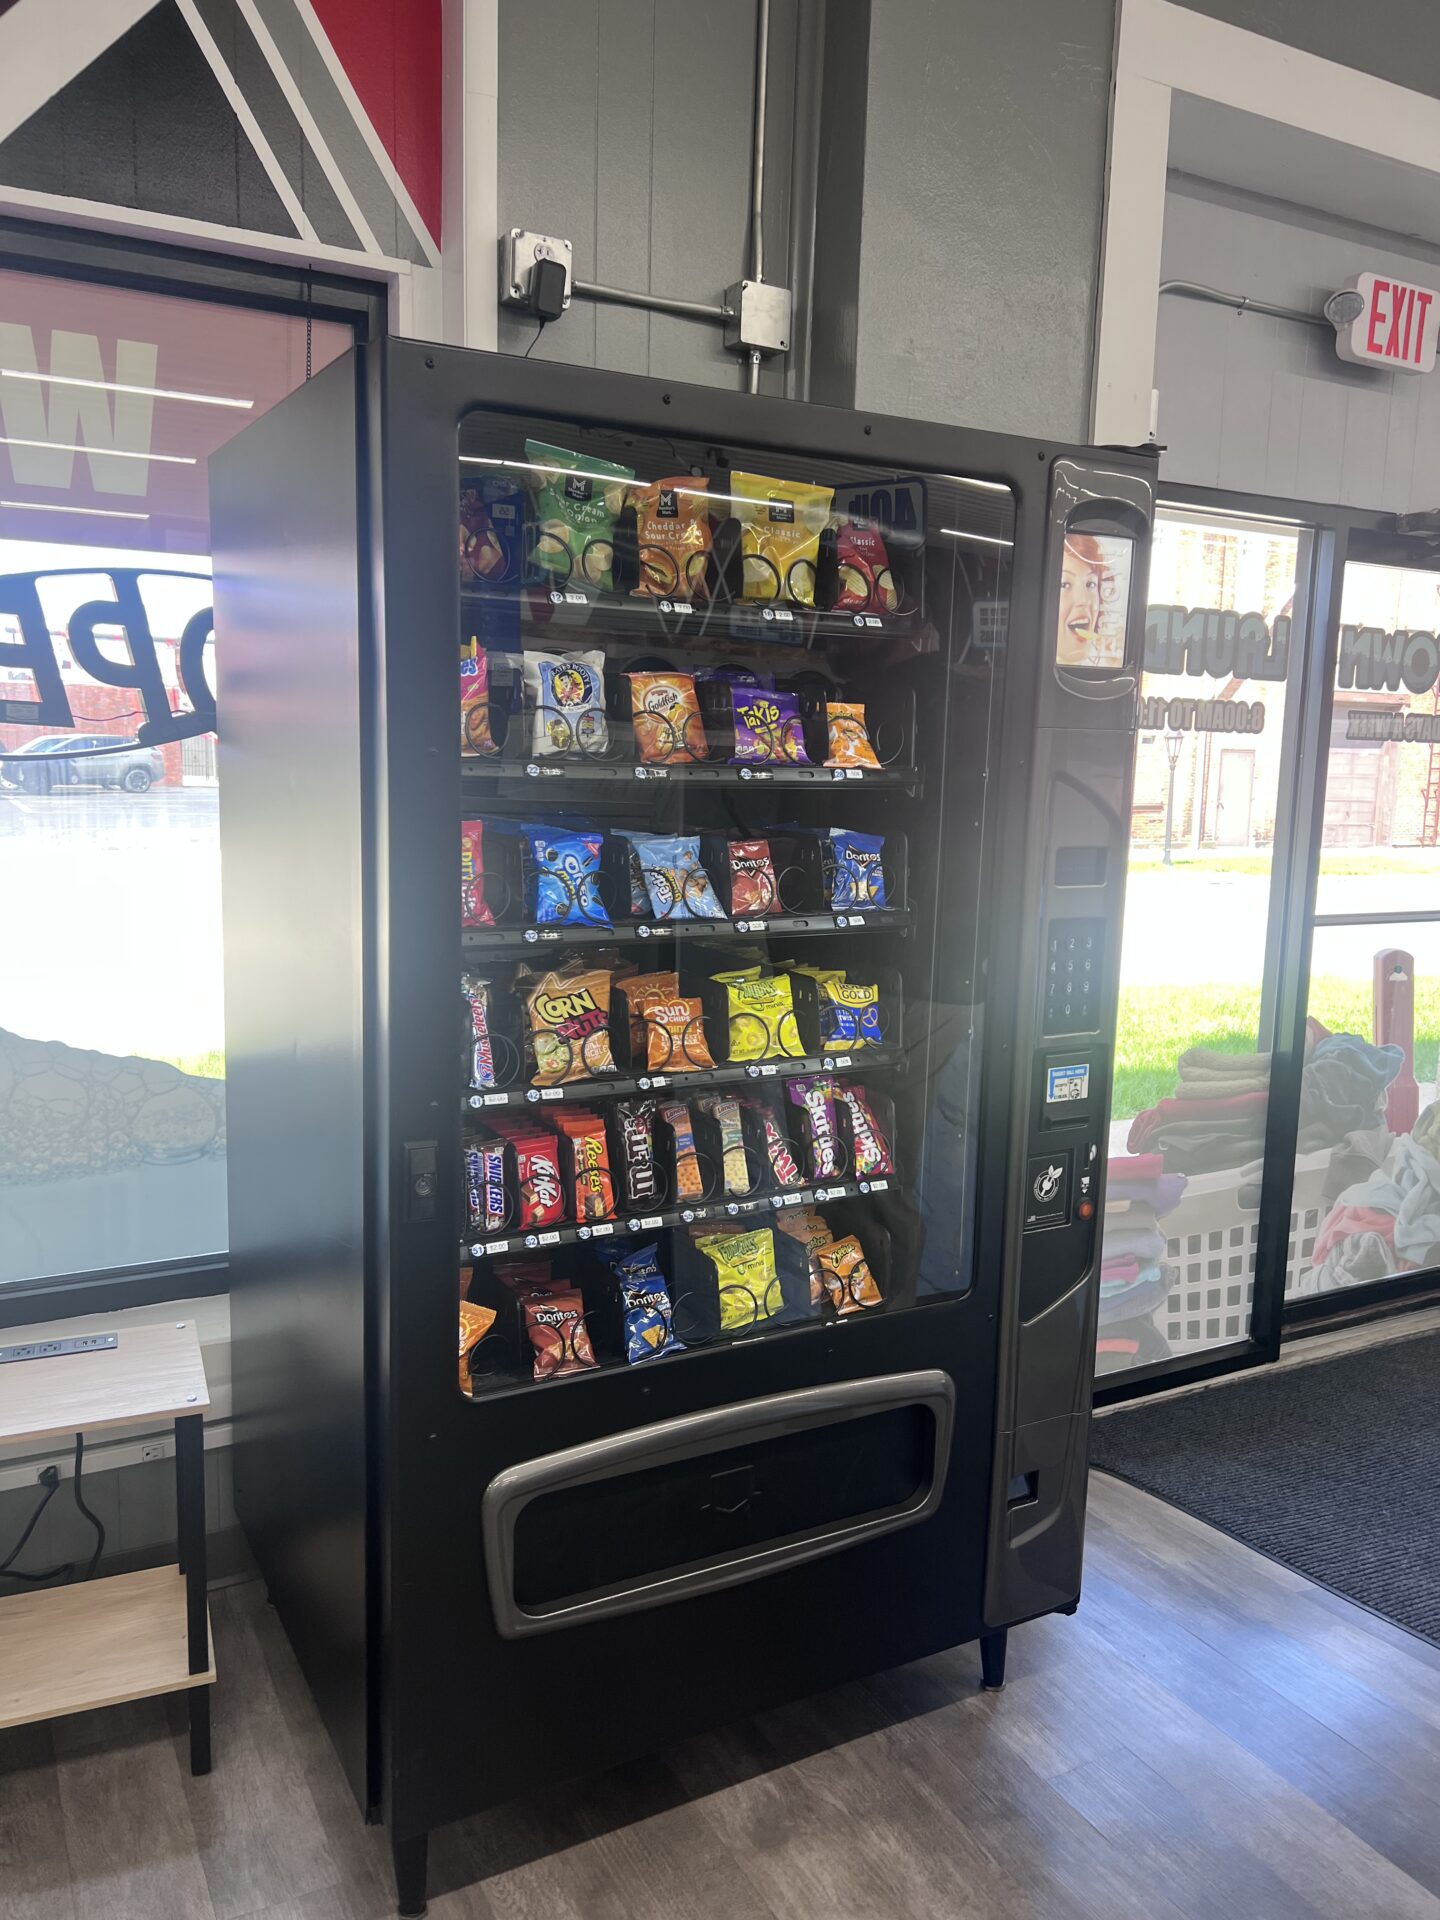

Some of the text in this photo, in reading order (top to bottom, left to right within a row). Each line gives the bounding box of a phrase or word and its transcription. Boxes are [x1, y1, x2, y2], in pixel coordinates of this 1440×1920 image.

[1366, 279, 1433, 364] EXIT
[573, 503, 605, 518] Cream
[646, 520, 686, 531] Cheddar
[644, 530, 666, 541] Sour
[763, 525, 801, 538] Classic
[851, 535, 876, 547] Classic
[551, 594, 562, 603] 12
[660, 602, 672, 611] 14
[762, 610, 773, 619] 16
[853, 616, 864, 626] 18
[647, 692, 679, 713] Goldfish
[736, 704, 780, 730] Takis
[528, 766, 538, 775] 22
[636, 768, 646, 776] 24
[742, 769, 751, 778] 26
[835, 769, 844, 778] 28
[845, 849, 882, 863] Doritos
[729, 856, 770, 871] Doritos
[837, 917, 847, 926] 38
[526, 931, 537, 940] 32
[639, 928, 649, 936] 34
[1053, 939, 1058, 951] 1
[1069, 937, 1076, 949] 2
[1086, 936, 1092, 948] 3
[1050, 961, 1056, 973] 4
[1068, 960, 1073, 970] 5
[1085, 959, 1091, 969] 6
[1050, 983, 1055, 995] 7
[1066, 981, 1072, 993] 8
[1083, 981, 1089, 992] 9
[841, 989, 872, 1000] GOLD
[535, 988, 596, 1025] CORN
[1065, 1004, 1071, 1015] 0
[654, 1005, 690, 1025] Sun
[668, 1015, 692, 1023] CHIPS
[555, 1007, 609, 1042] NUTS
[824, 1059, 834, 1067] 48
[749, 1067, 759, 1076] 46
[640, 1079, 650, 1088] 44
[528, 1090, 539, 1099] 42
[471, 1097, 481, 1106] 41
[665, 1106, 687, 1119] Lance
[717, 1103, 737, 1114] Lance
[842, 1091, 882, 1163] Skittles
[805, 1090, 836, 1176] Skittles
[583, 1136, 603, 1194] Reese's
[488, 1153, 504, 1215] SNICKERS
[530, 1155, 558, 1208] KitKat
[859, 1183, 869, 1192] 59
[772, 1196, 783, 1206] 57
[728, 1204, 738, 1213] 56
[683, 1212, 693, 1220] 55
[629, 1221, 639, 1230] 54
[579, 1228, 590, 1237] 53
[526, 1234, 558, 1246] 52 $2.00
[472, 1246, 483, 1255] 51
[718, 1236, 760, 1261] FUNYUNS
[830, 1242, 856, 1268] Cheetos
[747, 1260, 765, 1270] minis
[624, 1290, 668, 1309] Doritos
[535, 1310, 578, 1323] Doritos
